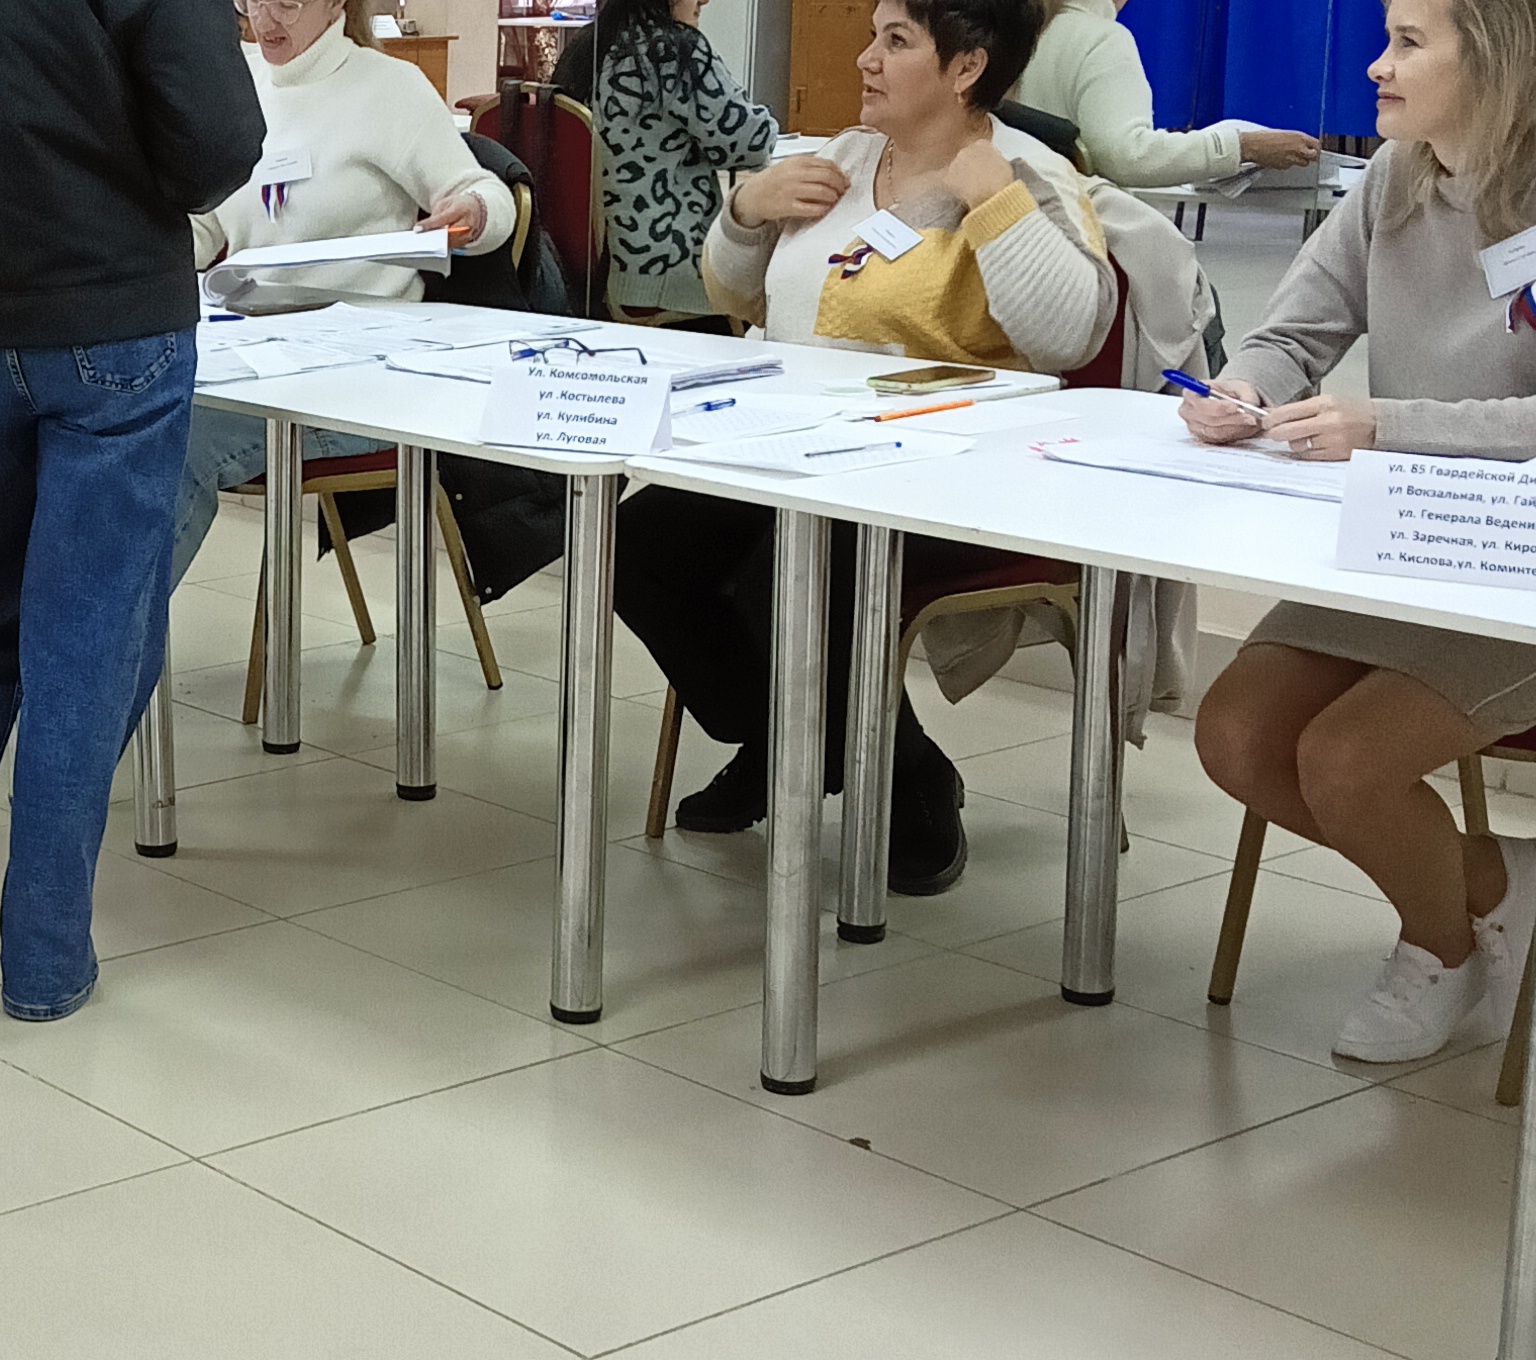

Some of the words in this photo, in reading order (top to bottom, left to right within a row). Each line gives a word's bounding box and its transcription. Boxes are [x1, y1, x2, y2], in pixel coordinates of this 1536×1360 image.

[528, 366, 545, 378] Ул.
[550, 368, 648, 384] Комсомольская
[537, 411, 552, 421] ул.
[558, 410, 617, 426] Кулибина
[536, 432, 553, 442] ул.
[557, 431, 607, 445] Луговая
[1388, 463, 1405, 474] ул.
[1410, 463, 1426, 474] 85
[1430, 465, 1515, 483] Гвардейской
[1406, 485, 1486, 503] Вокзальная,
[1491, 495, 1509, 506] ул.
[1398, 509, 1416, 519] ул.
[1421, 509, 1481, 525] Генерала
[1412, 530, 1477, 548] Заречная,
[1377, 551, 1394, 561] ул.
